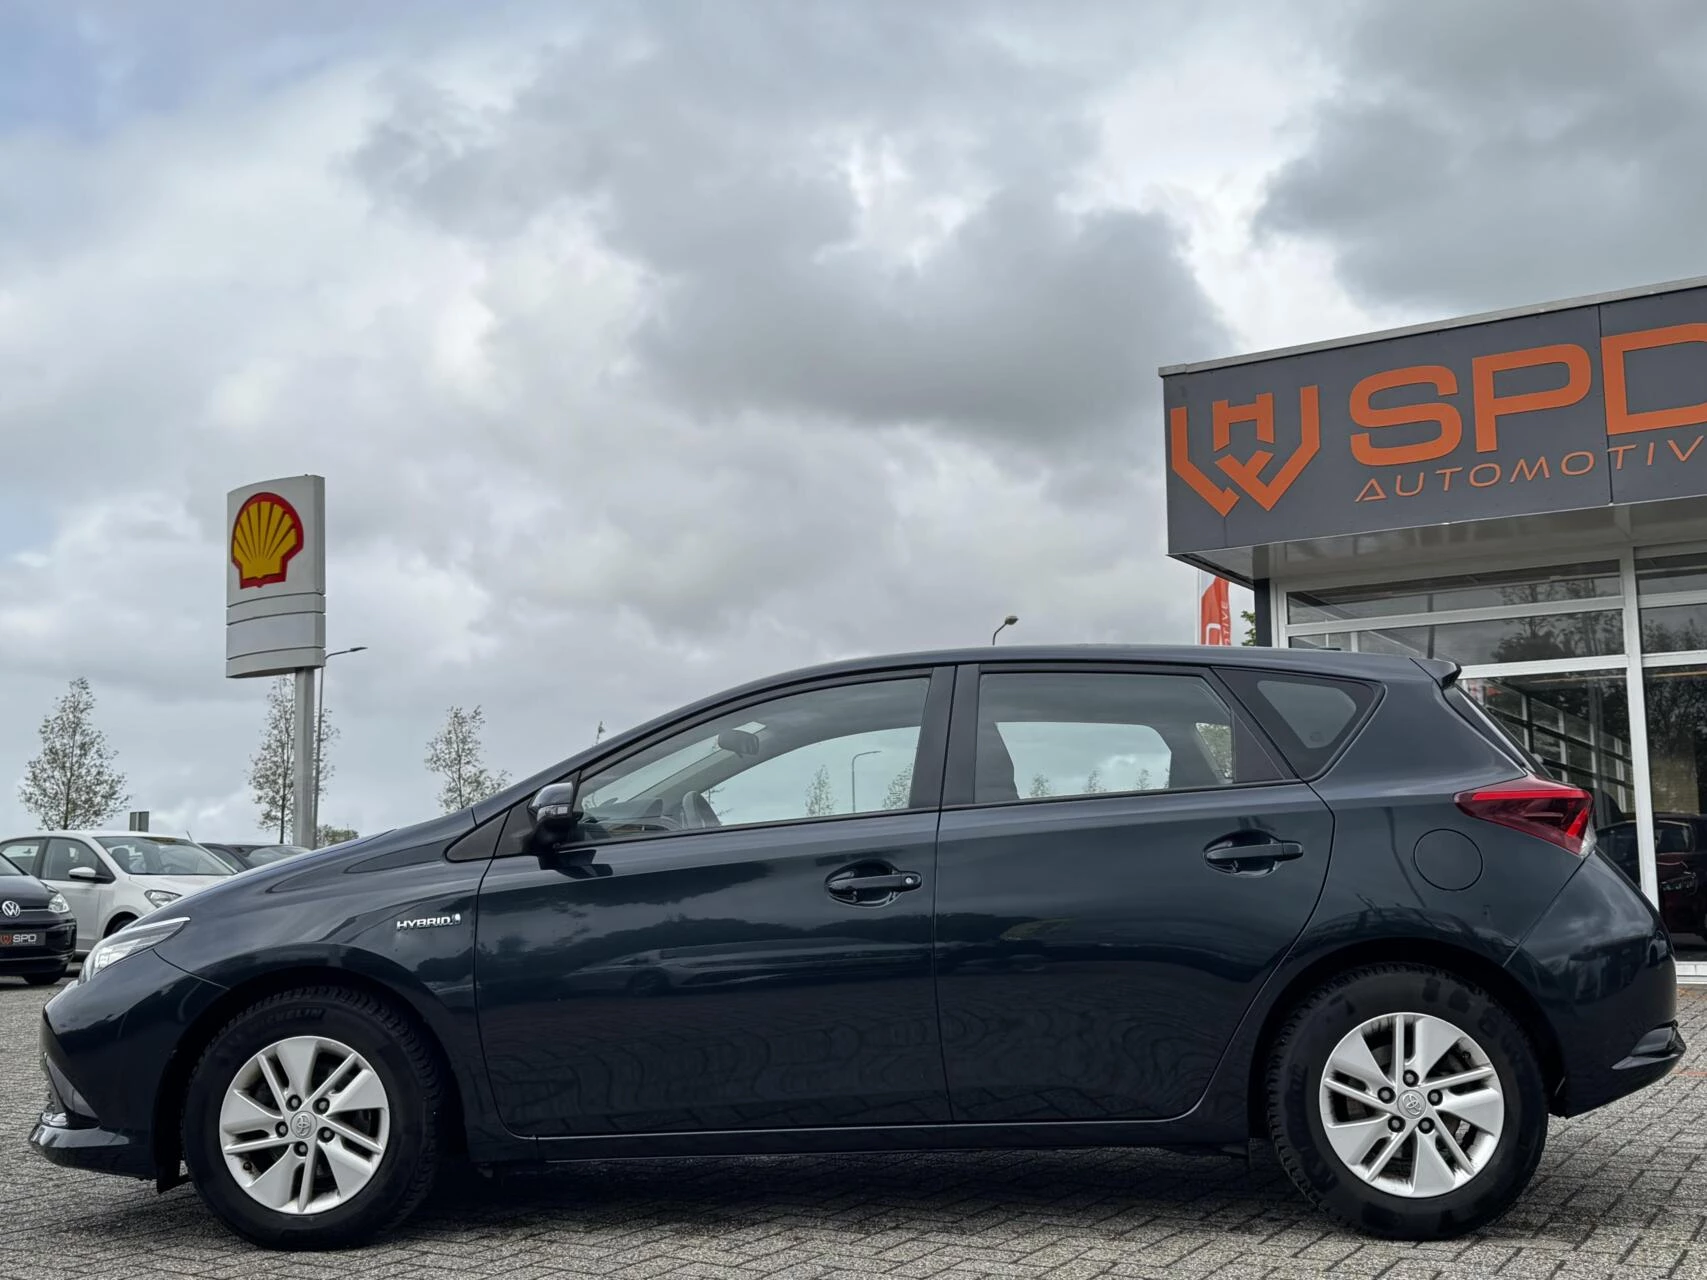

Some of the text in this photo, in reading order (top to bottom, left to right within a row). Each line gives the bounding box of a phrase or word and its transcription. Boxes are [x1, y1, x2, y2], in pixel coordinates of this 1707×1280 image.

[1350, 323, 1707, 467] SPD
[1355, 435, 1704, 503] AUTOMOTIV
[396, 916, 451, 930] HYBRID
